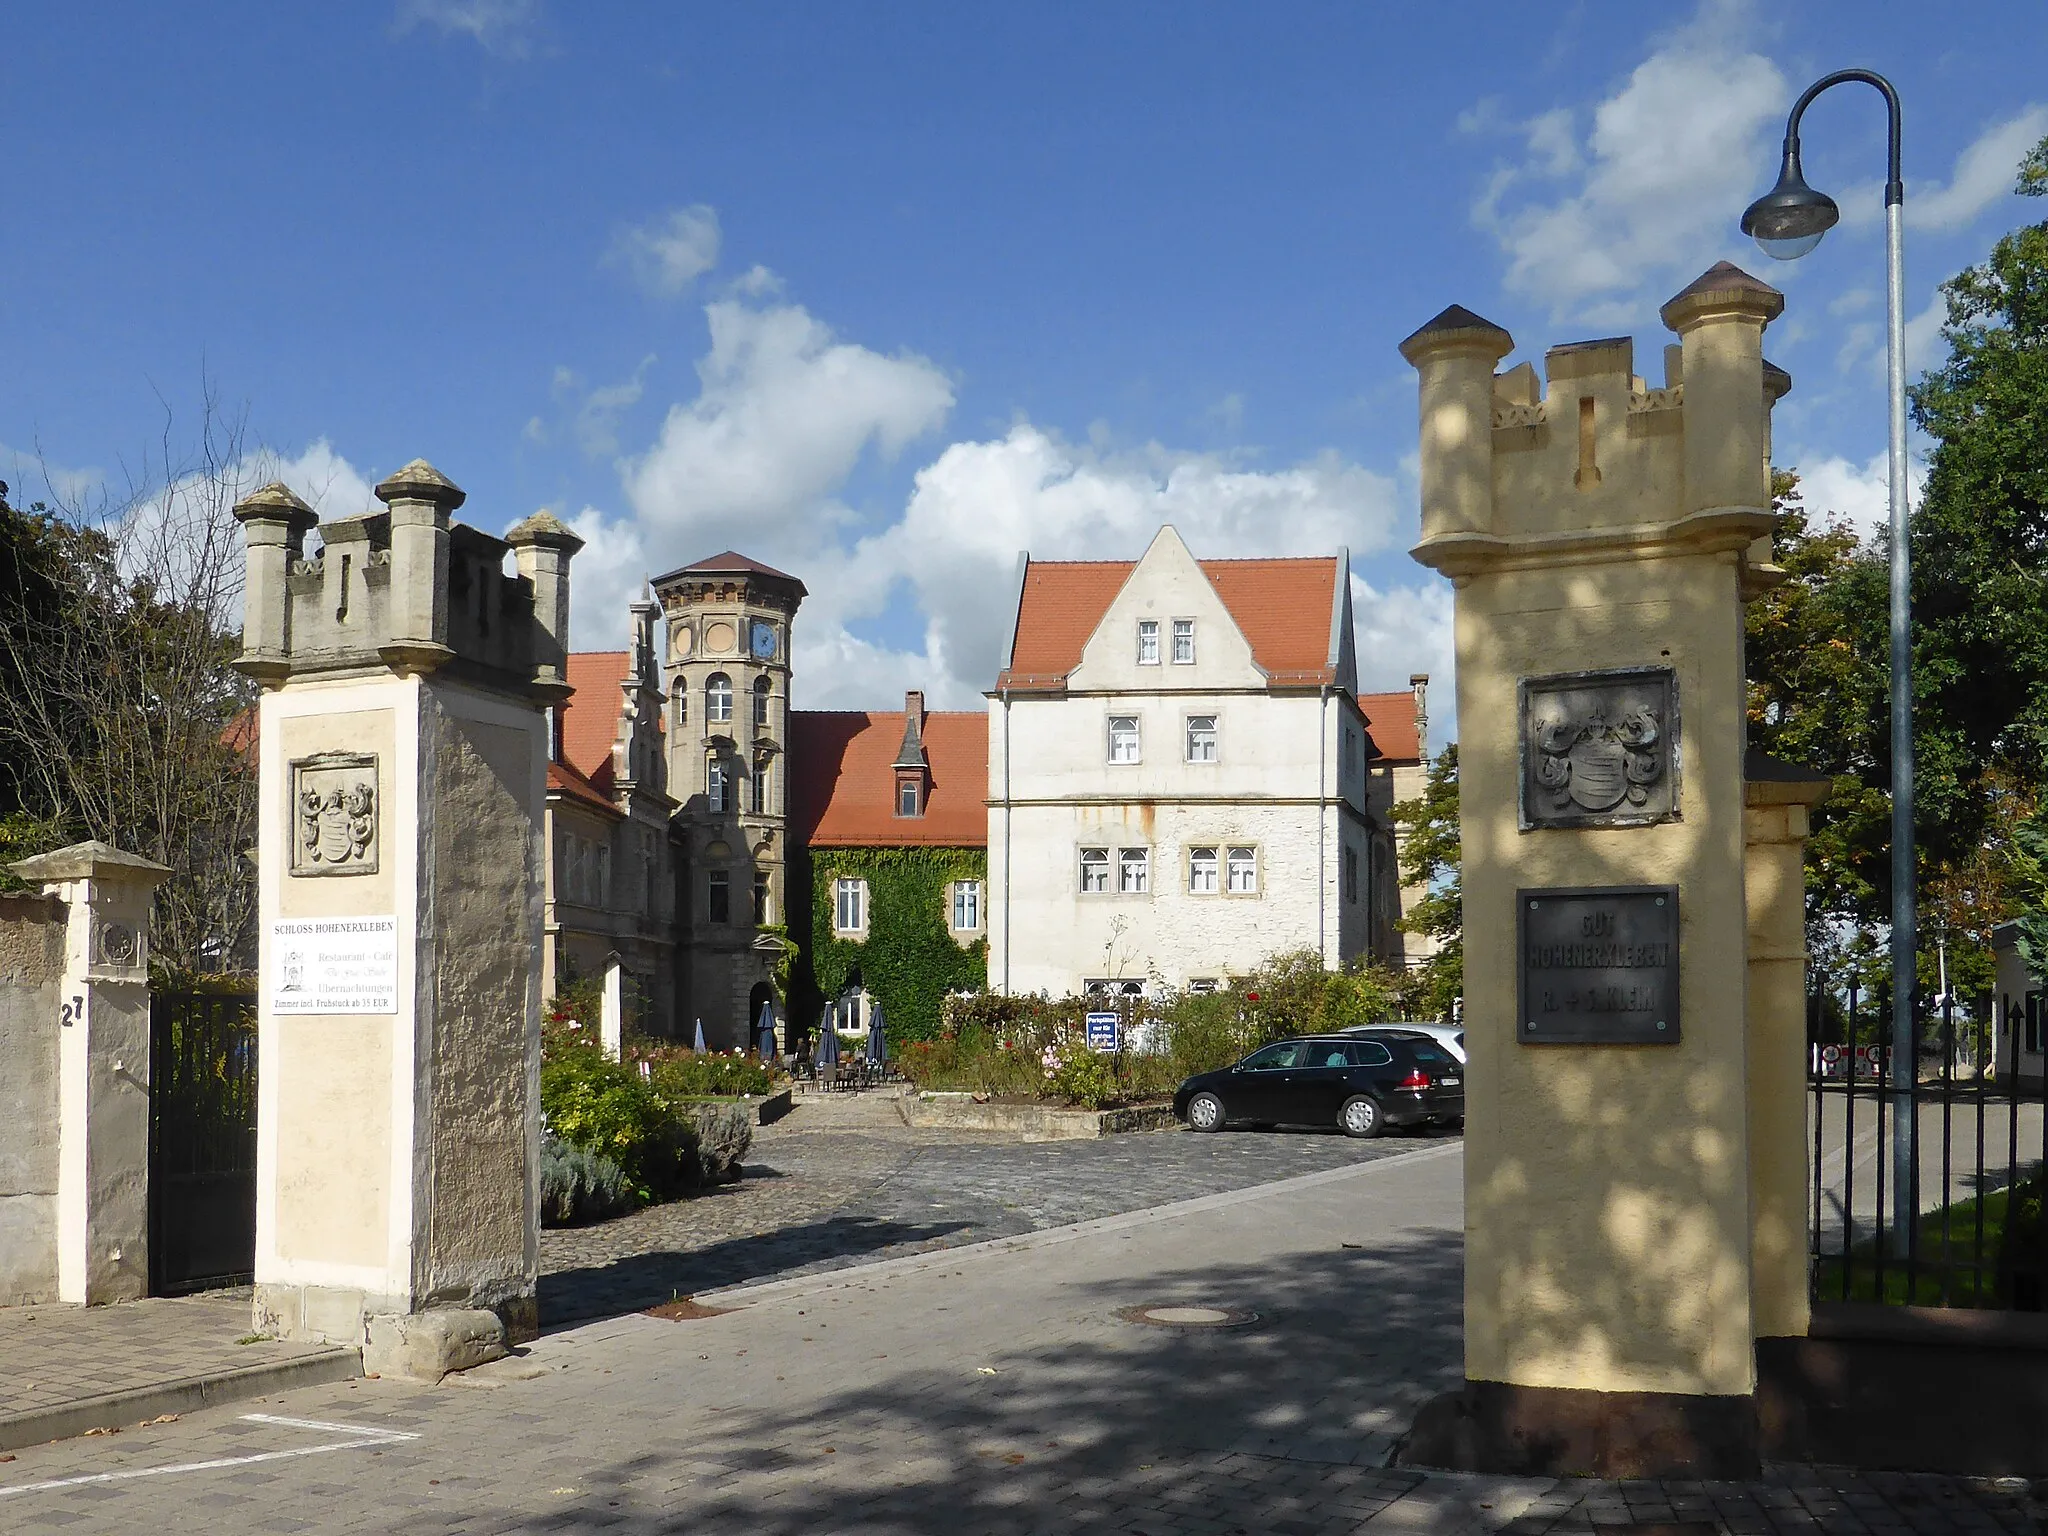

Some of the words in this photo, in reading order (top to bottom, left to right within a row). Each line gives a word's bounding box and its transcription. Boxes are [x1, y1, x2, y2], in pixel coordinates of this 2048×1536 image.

[274, 924, 313, 935] SCHLOSS
[315, 922, 393, 934] HOHENERXLEBEN
[1581, 911, 1615, 937] GUT
[318, 952, 365, 962] Restaurant
[1529, 942, 1668, 969] HOHENERXLEBEN
[61, 995, 84, 1028] 27
[274, 999, 299, 1008] Zimmer
[351, 998, 361, 1007] ab
[373, 998, 389, 1007] EUR
